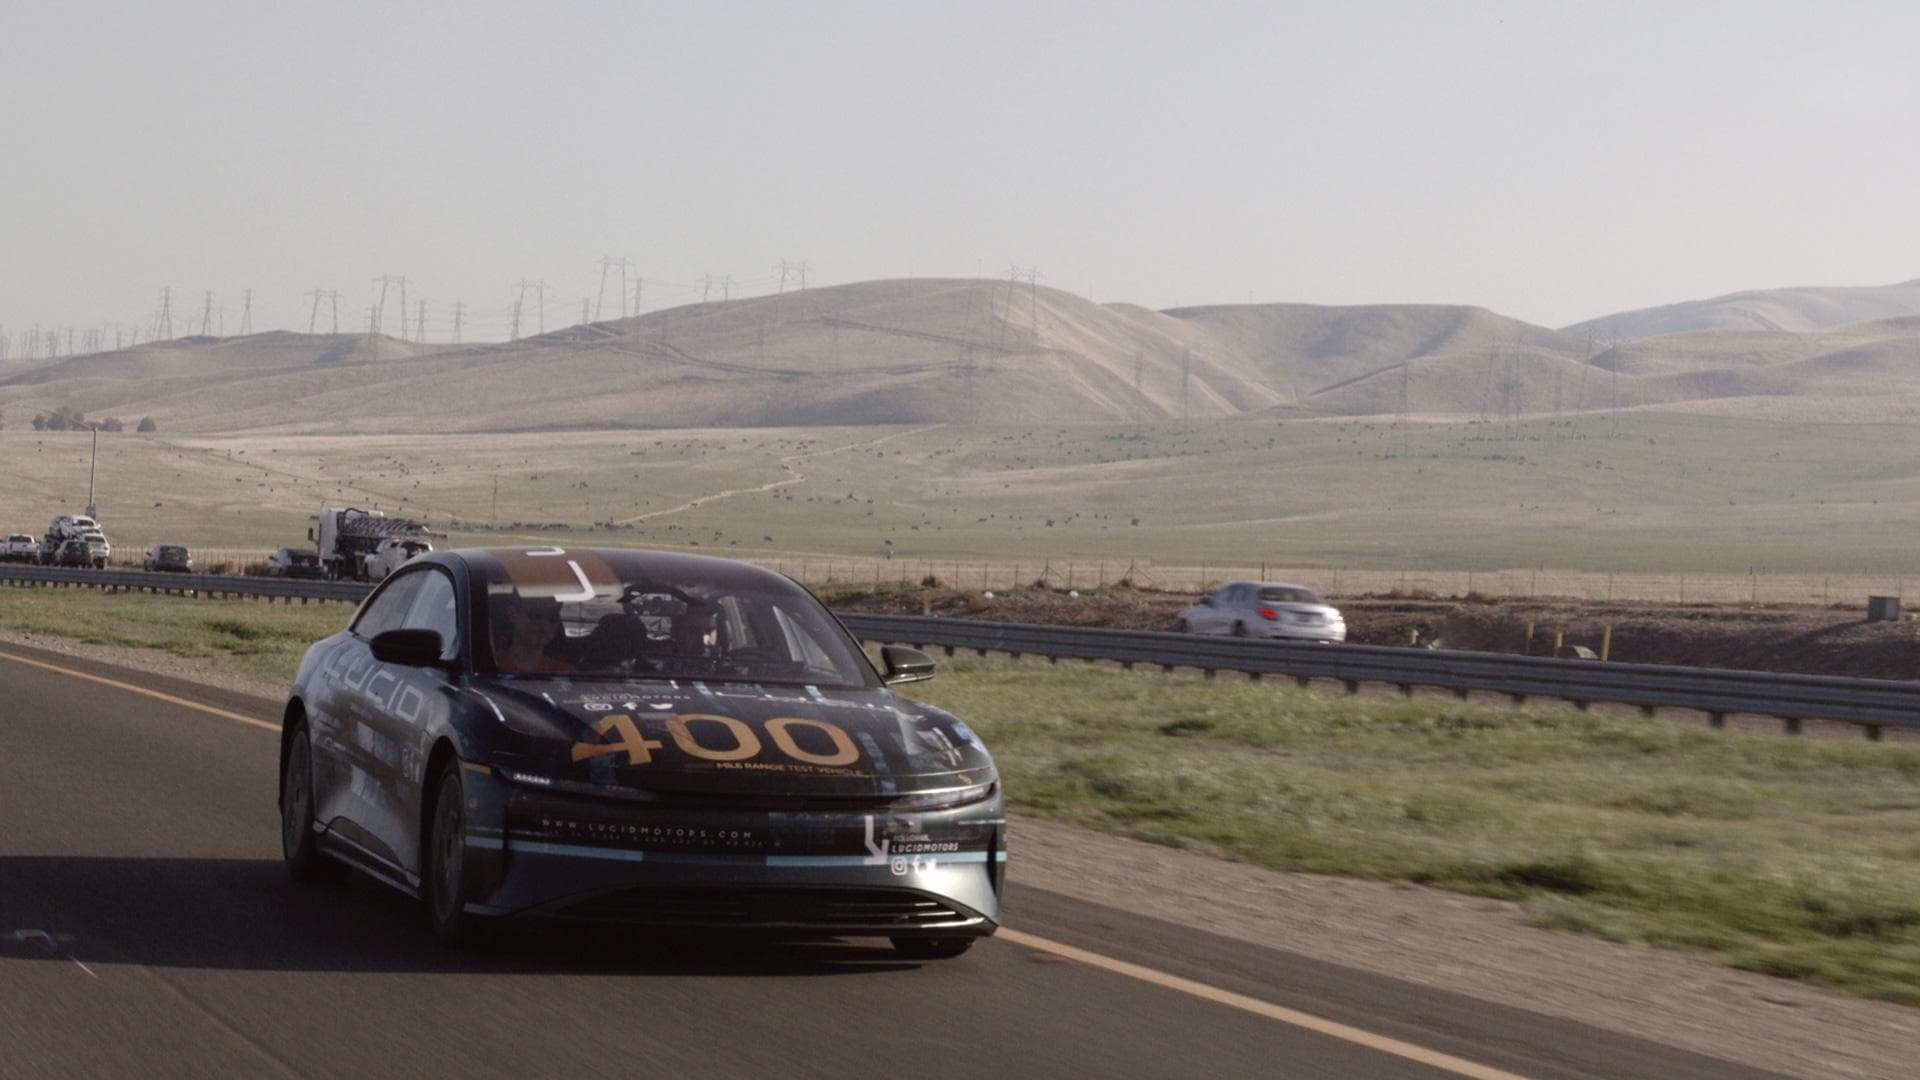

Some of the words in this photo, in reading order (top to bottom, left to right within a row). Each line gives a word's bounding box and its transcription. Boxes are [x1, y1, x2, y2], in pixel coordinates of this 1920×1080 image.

[323, 644, 424, 724] LUCID
[571, 713, 860, 766] 400
[716, 762, 743, 770] MILE
[744, 763, 785, 772] RANGE
[788, 765, 814, 773] TEST
[816, 767, 864, 778] VEHICLE
[891, 842, 959, 853] LUCIDMOTORS
